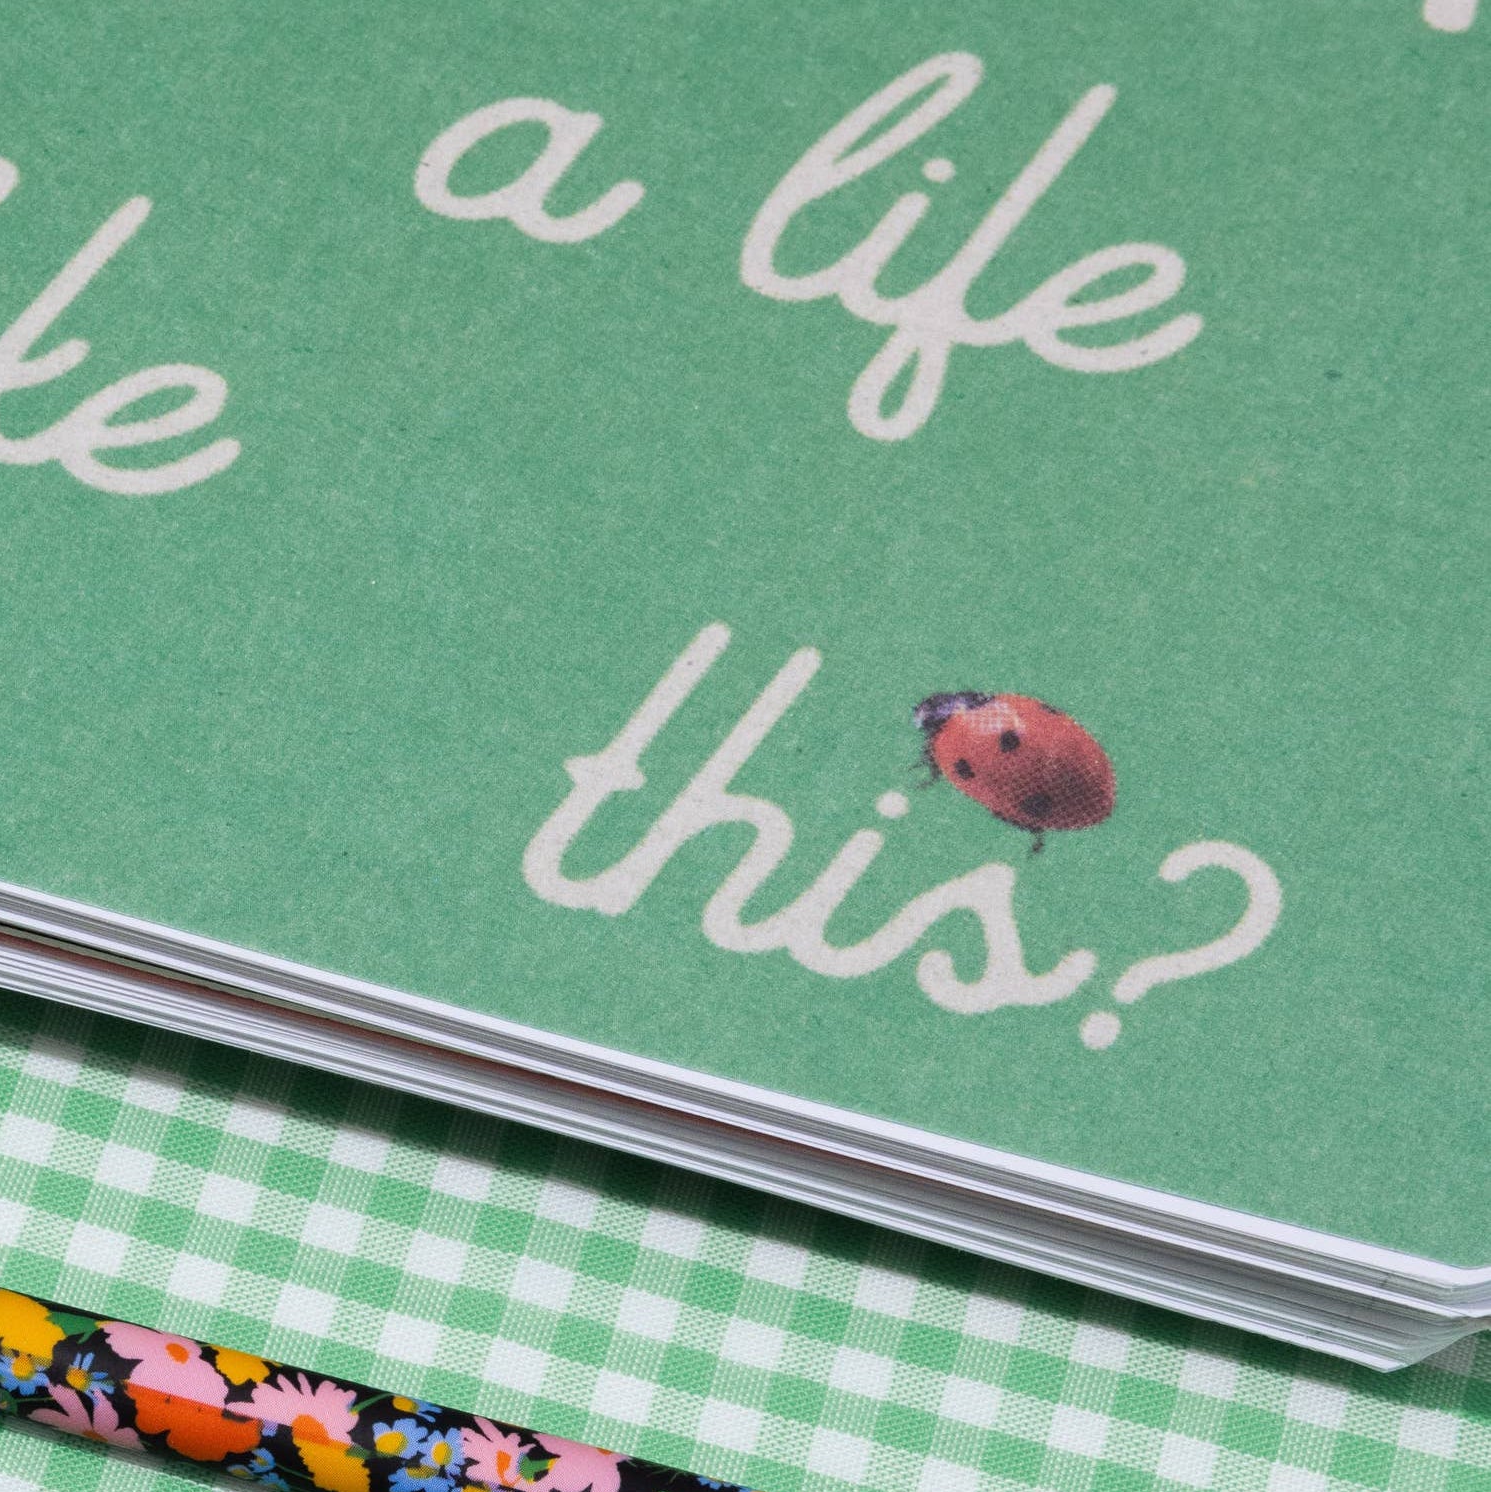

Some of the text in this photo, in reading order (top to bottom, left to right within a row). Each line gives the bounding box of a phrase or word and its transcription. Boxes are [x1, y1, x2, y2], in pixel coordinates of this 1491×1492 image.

[411, 50, 1205, 443] a life
[520, 619, 1287, 1051] this?
